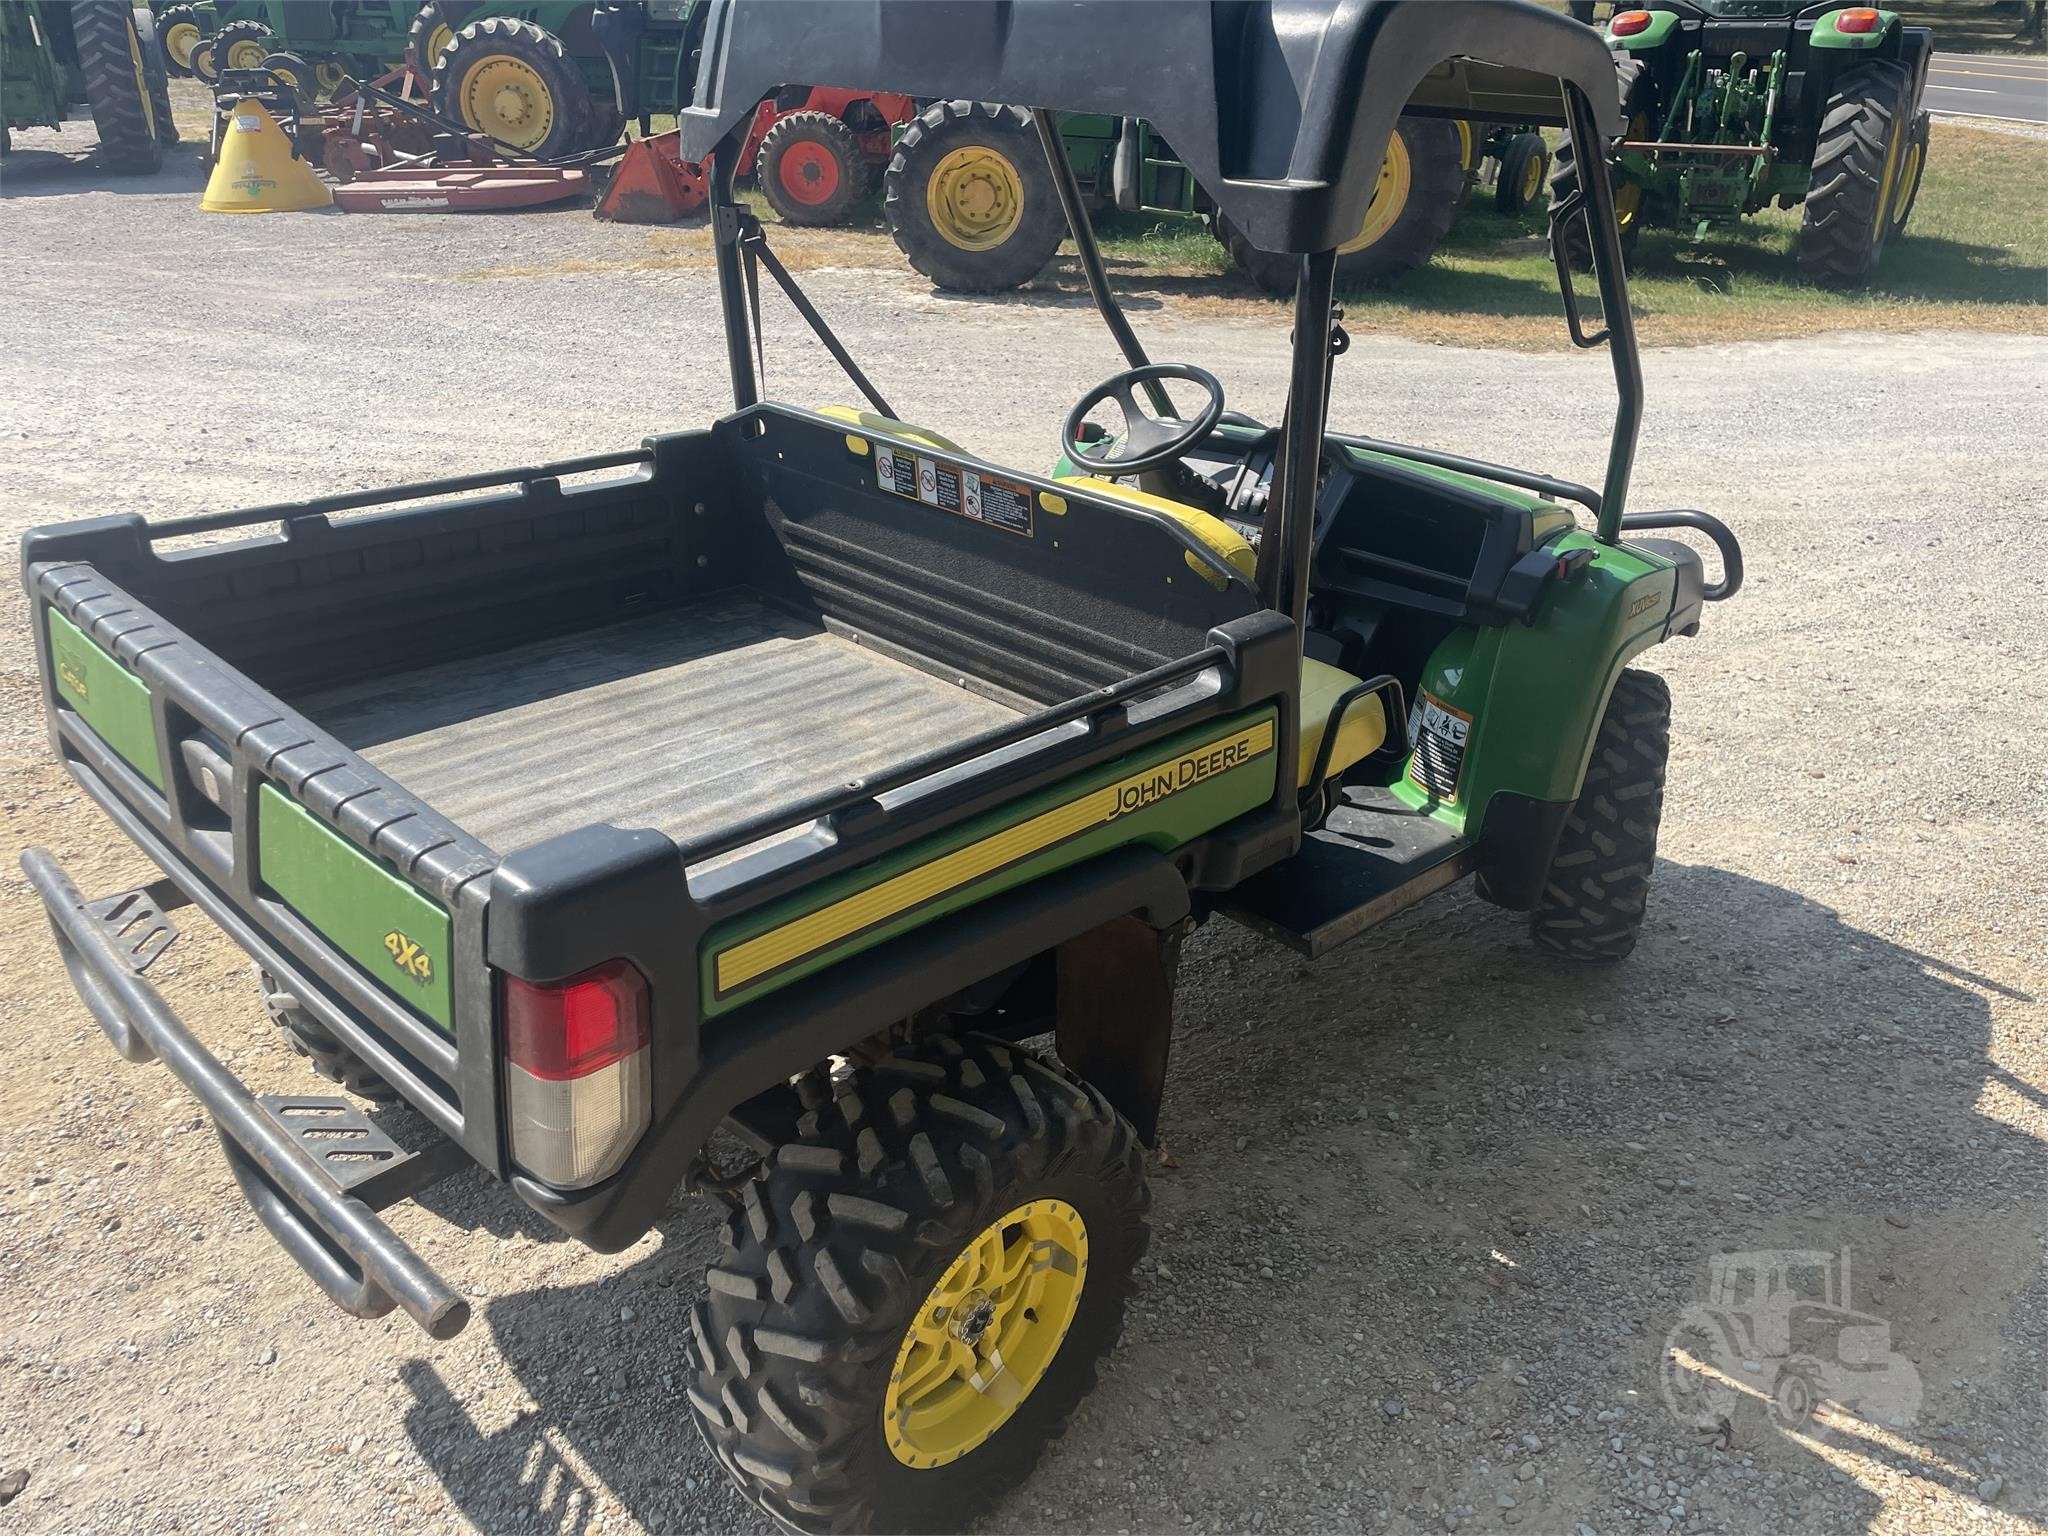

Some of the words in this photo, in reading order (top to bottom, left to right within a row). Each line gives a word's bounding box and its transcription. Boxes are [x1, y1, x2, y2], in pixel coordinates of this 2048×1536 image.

[1108, 770, 1173, 818] JOHN
[1178, 738, 1250, 787] DEERE
[384, 931, 431, 978] 4X4
